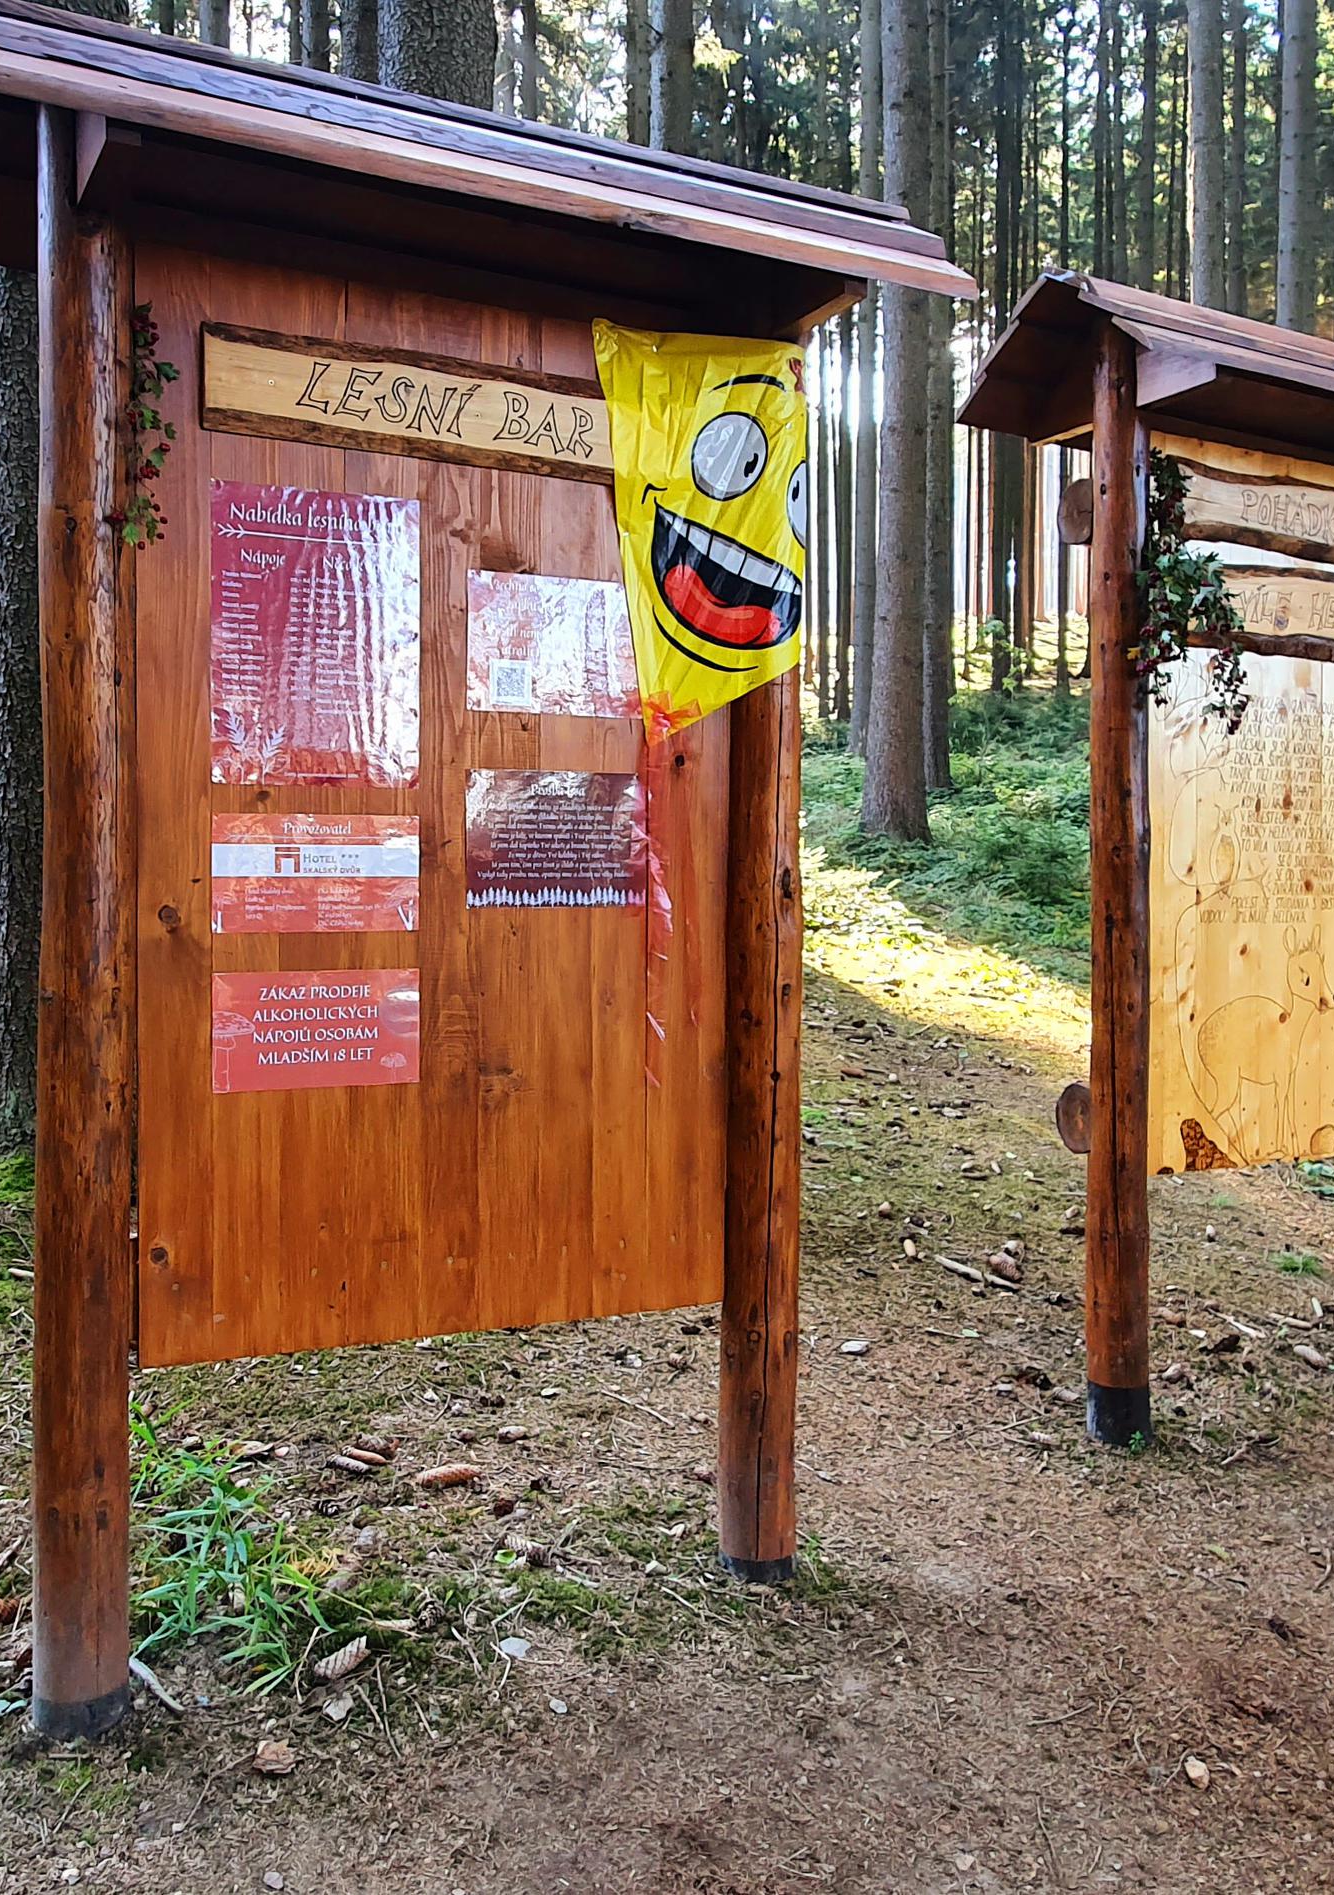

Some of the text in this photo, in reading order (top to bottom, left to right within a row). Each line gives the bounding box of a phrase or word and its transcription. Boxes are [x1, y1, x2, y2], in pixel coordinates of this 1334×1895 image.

[295, 361, 594, 458] LESNÍ BAR
[230, 502, 303, 528] Nabídka
[240, 549, 286, 571] Nápoje
[283, 821, 352, 836] Provozovatel
[303, 865, 338, 874] SKALSKÝ
[259, 984, 371, 1001] ZÁKAZ PRODEJE
[252, 1003, 378, 1023] ALKOHOLICKÝCH
[315, 1025, 378, 1042] OSOBÁM
[258, 1047, 374, 1065] MLADŠÍM 18 LET
